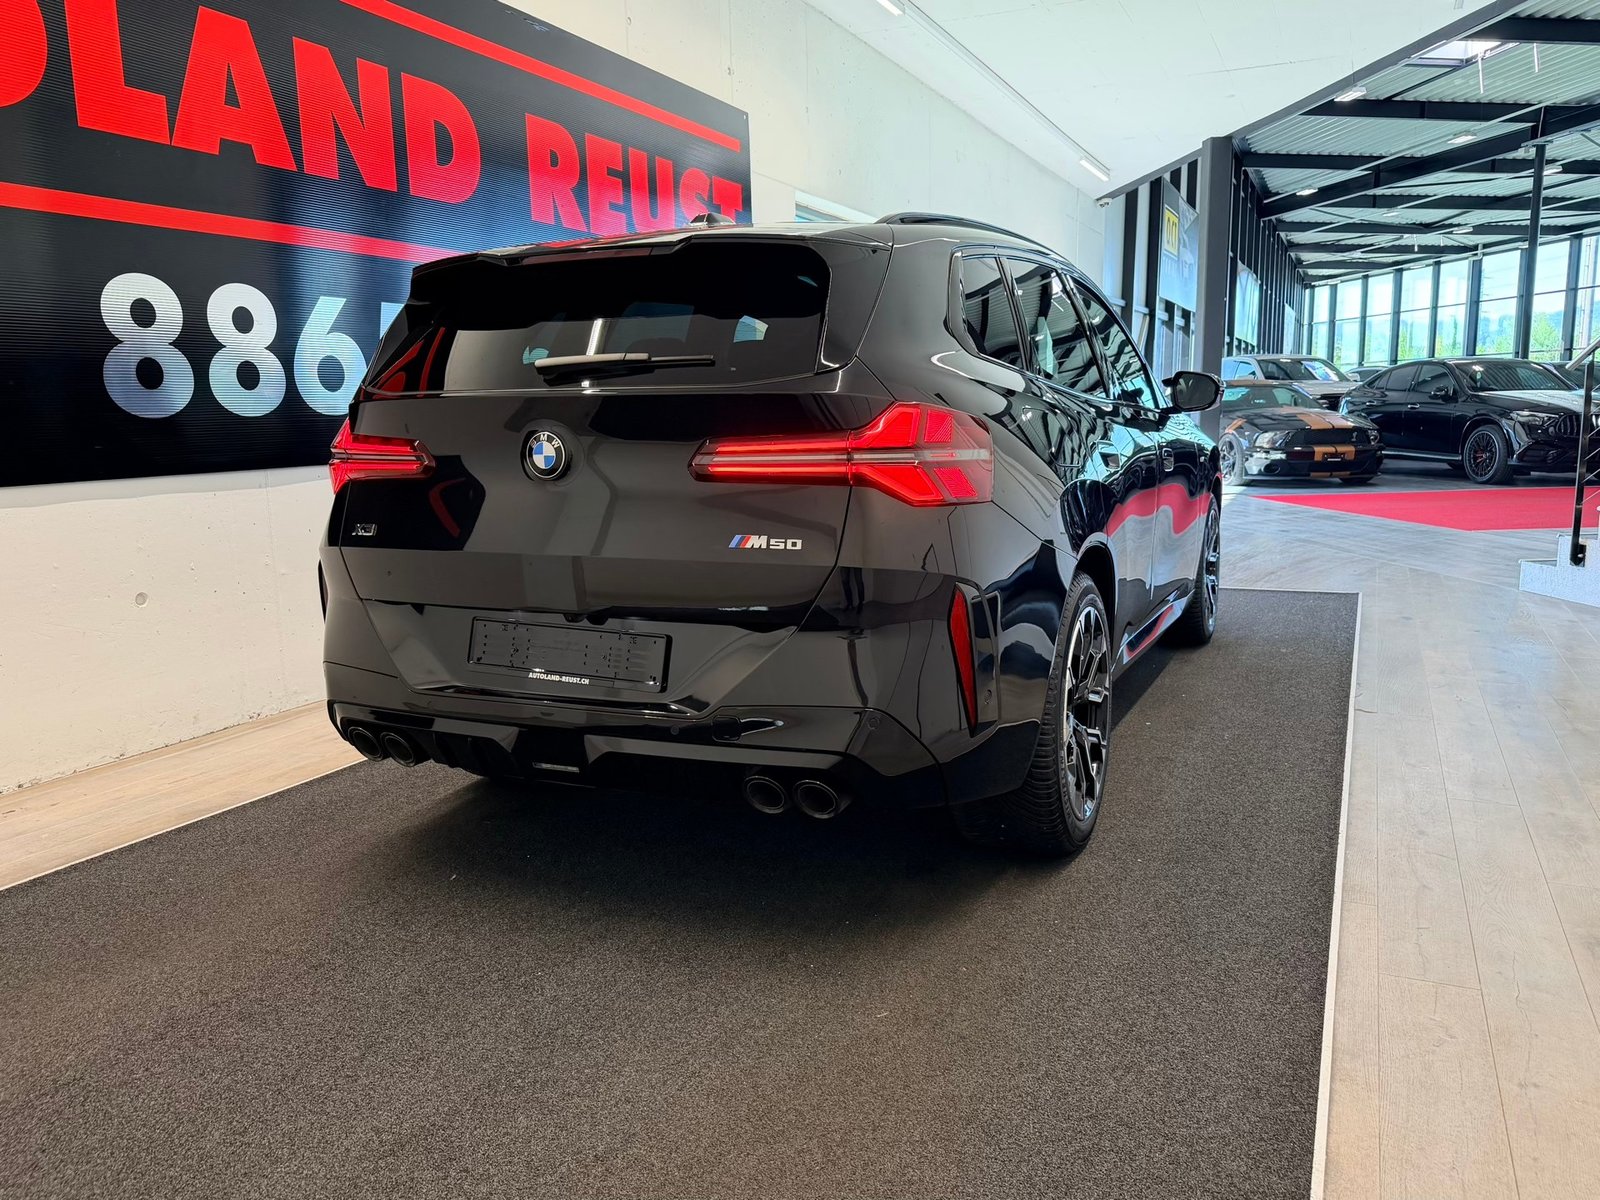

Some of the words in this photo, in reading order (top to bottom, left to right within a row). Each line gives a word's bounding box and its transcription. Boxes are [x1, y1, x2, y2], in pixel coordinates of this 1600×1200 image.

[525, 113, 743, 238] REUST
[100, 272, 405, 417] 886
[530, 433, 561, 449] BMW
[528, 671, 590, 686] AUTOLAND-REUST.CH
